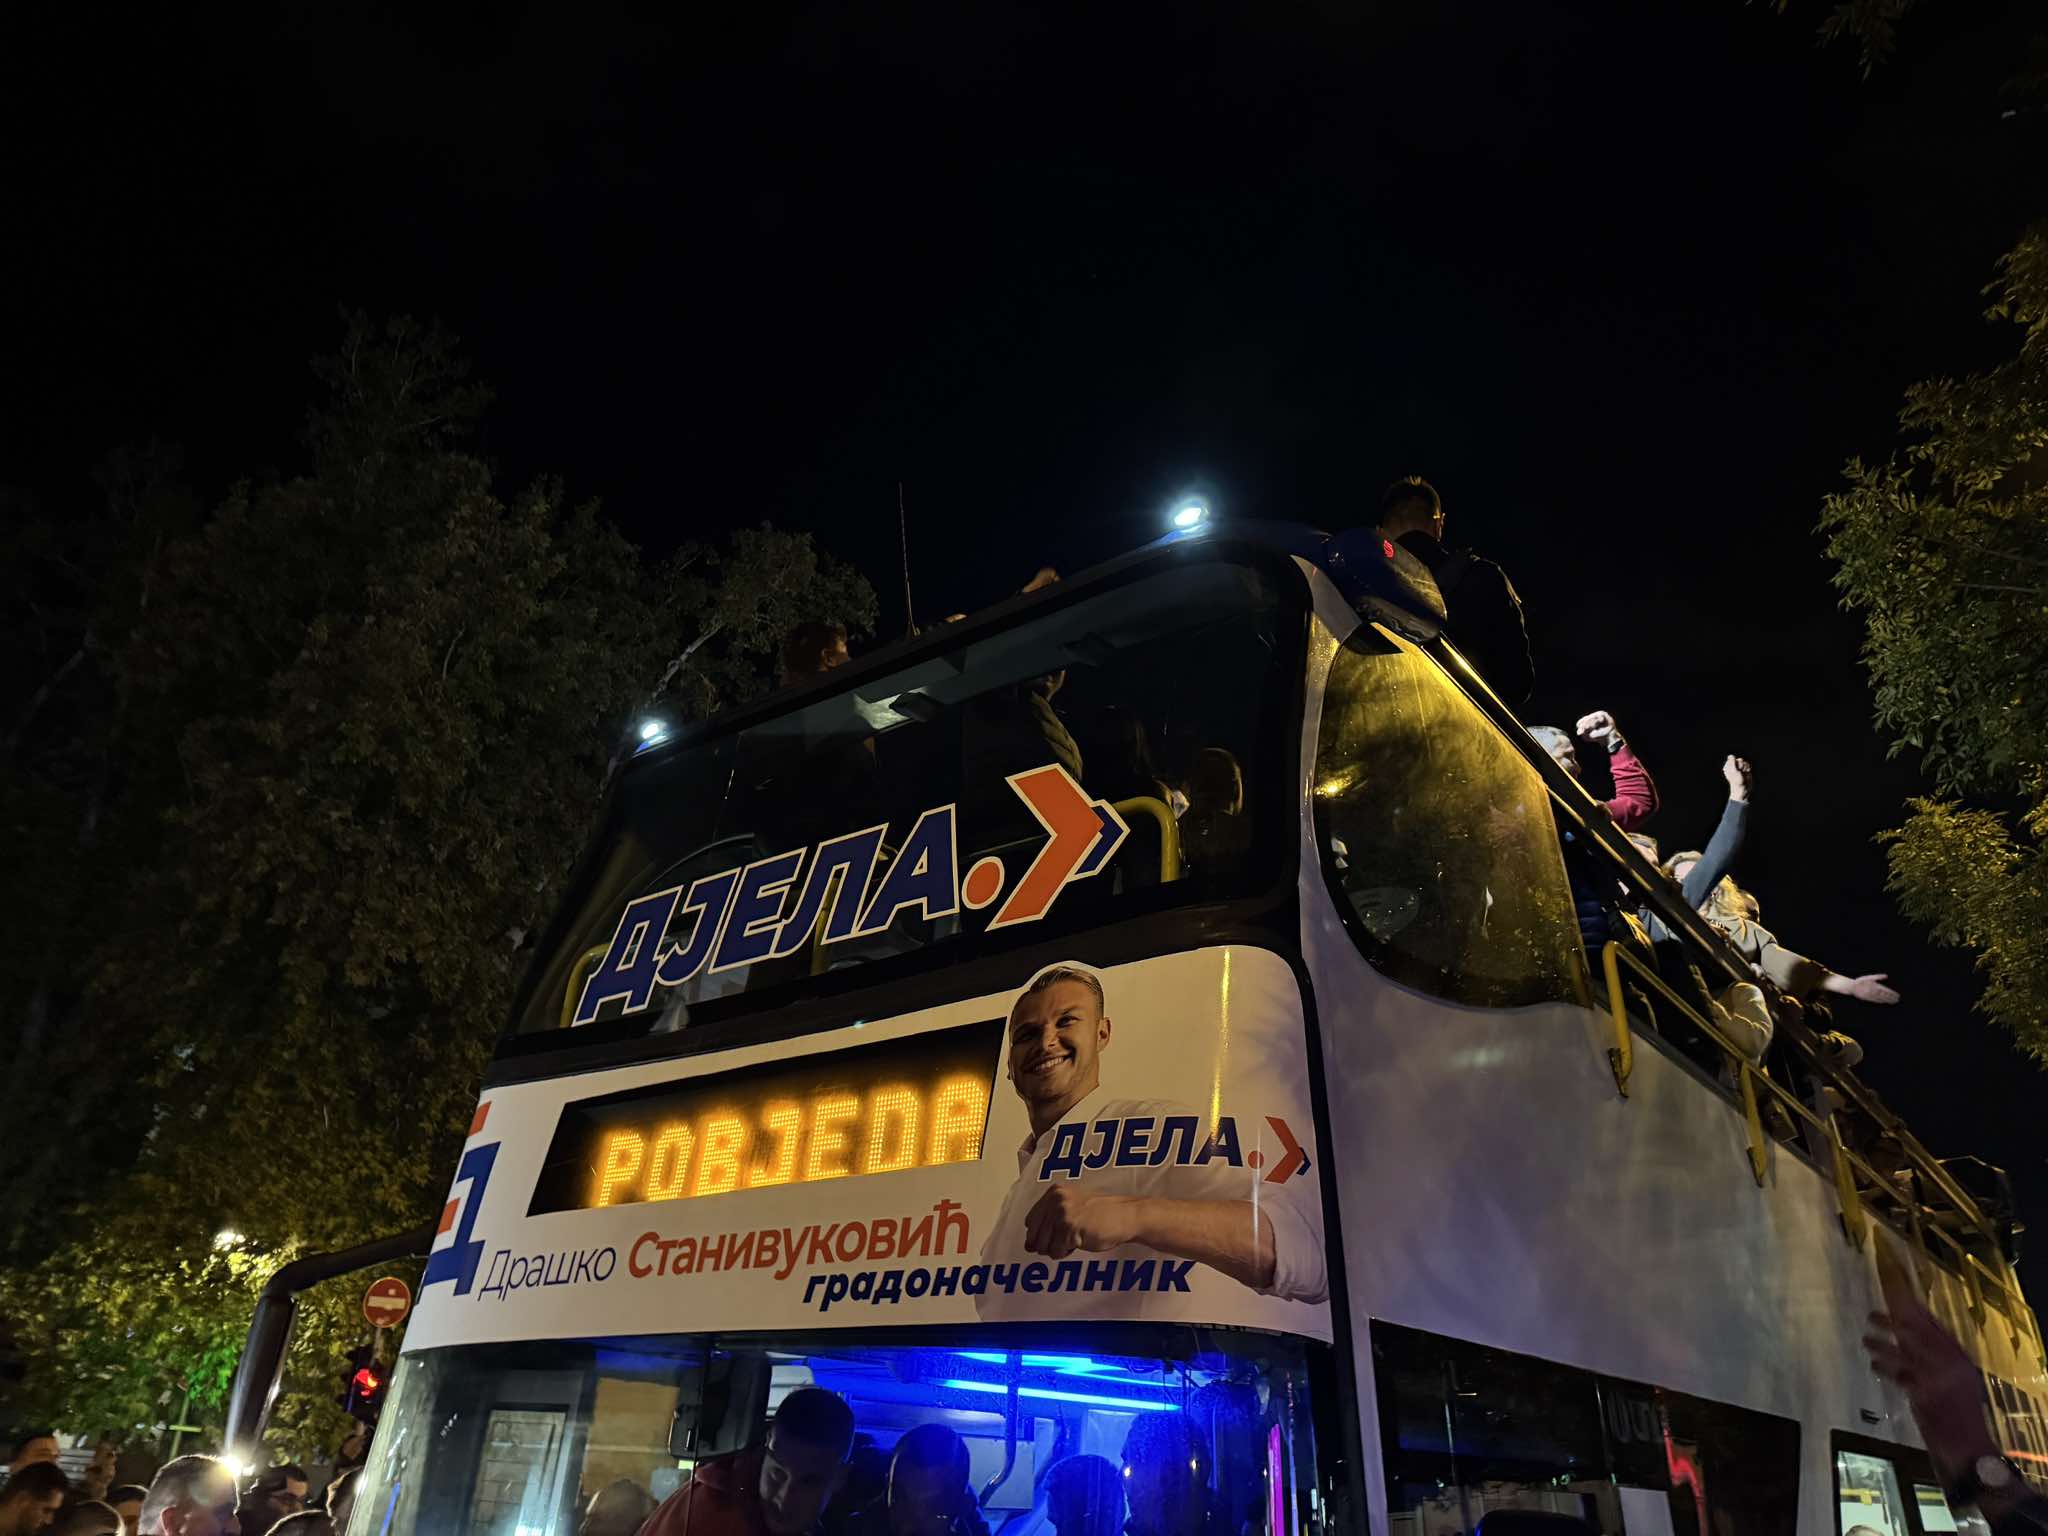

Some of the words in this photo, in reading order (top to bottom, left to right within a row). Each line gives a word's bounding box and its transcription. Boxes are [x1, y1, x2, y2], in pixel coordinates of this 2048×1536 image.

[598, 1079, 985, 1208] POBJEDA
[478, 1247, 616, 1301] Драшко
[628, 1199, 970, 1281] Станивуковић
[802, 1260, 1198, 1311] градоначелник
